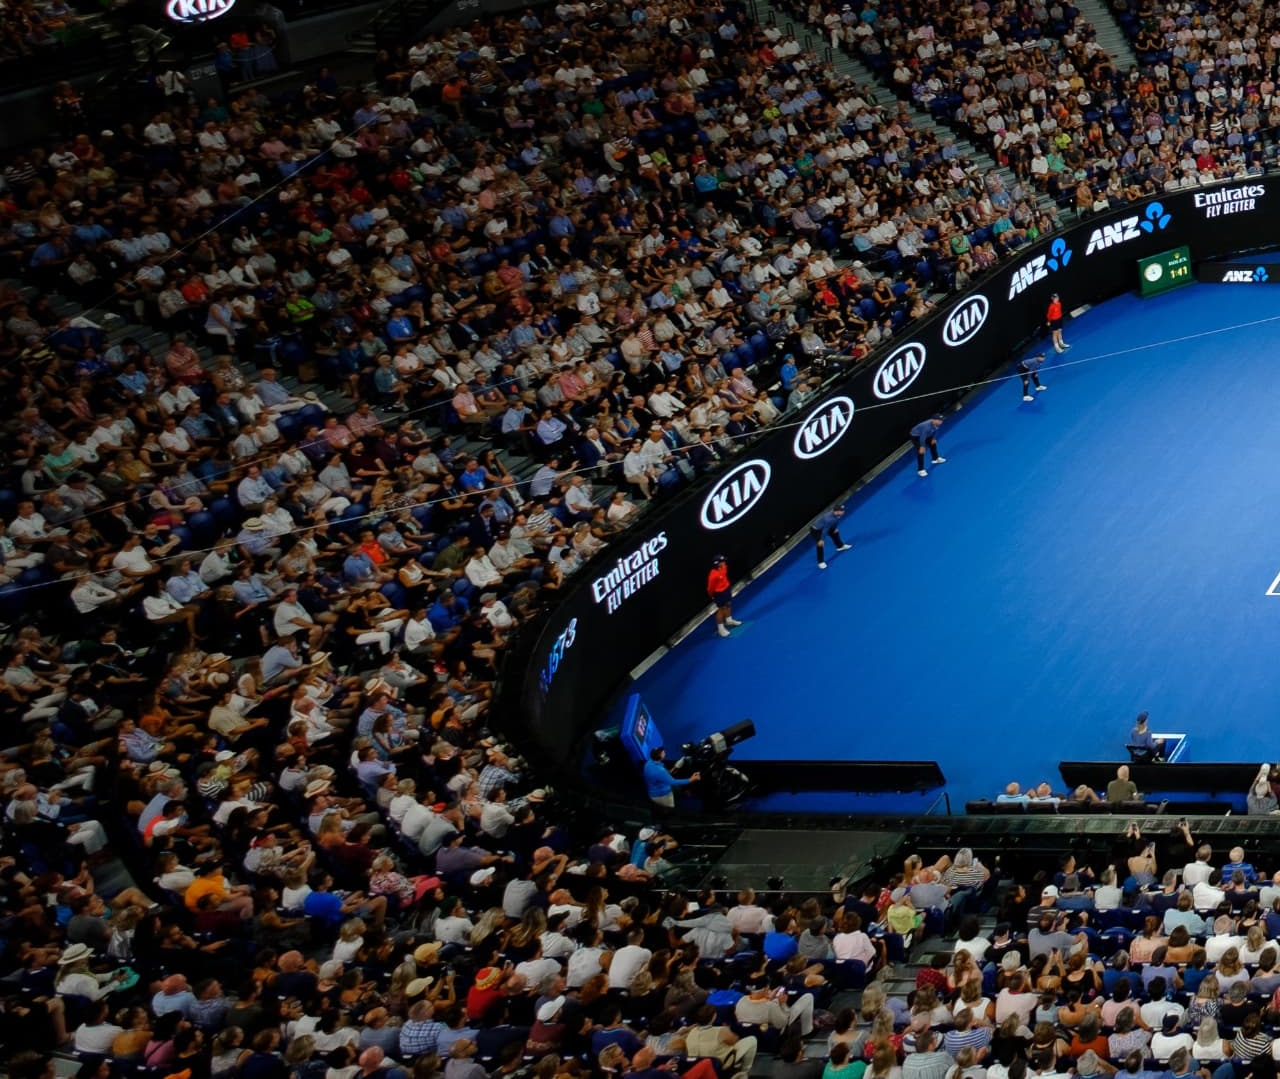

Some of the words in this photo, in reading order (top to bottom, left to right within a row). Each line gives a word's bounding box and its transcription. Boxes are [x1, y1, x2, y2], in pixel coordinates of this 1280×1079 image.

[1194, 184, 1265, 208] Emirates
[1206, 203, 1221, 218] FLY
[1223, 199, 1255, 213] BETTER
[1085, 216, 1141, 256] ANZ
[1008, 254, 1048, 301] ANZ
[1170, 266, 1188, 279] 1:41
[1222, 271, 1253, 282] ANZ
[952, 304, 982, 339] KIA
[883, 352, 918, 392] KIA
[805, 405, 846, 451] KIA
[713, 470, 761, 520] KIA
[592, 531, 668, 603] Emirates
[607, 586, 622, 614] FLY
[624, 558, 659, 599] BETTER
